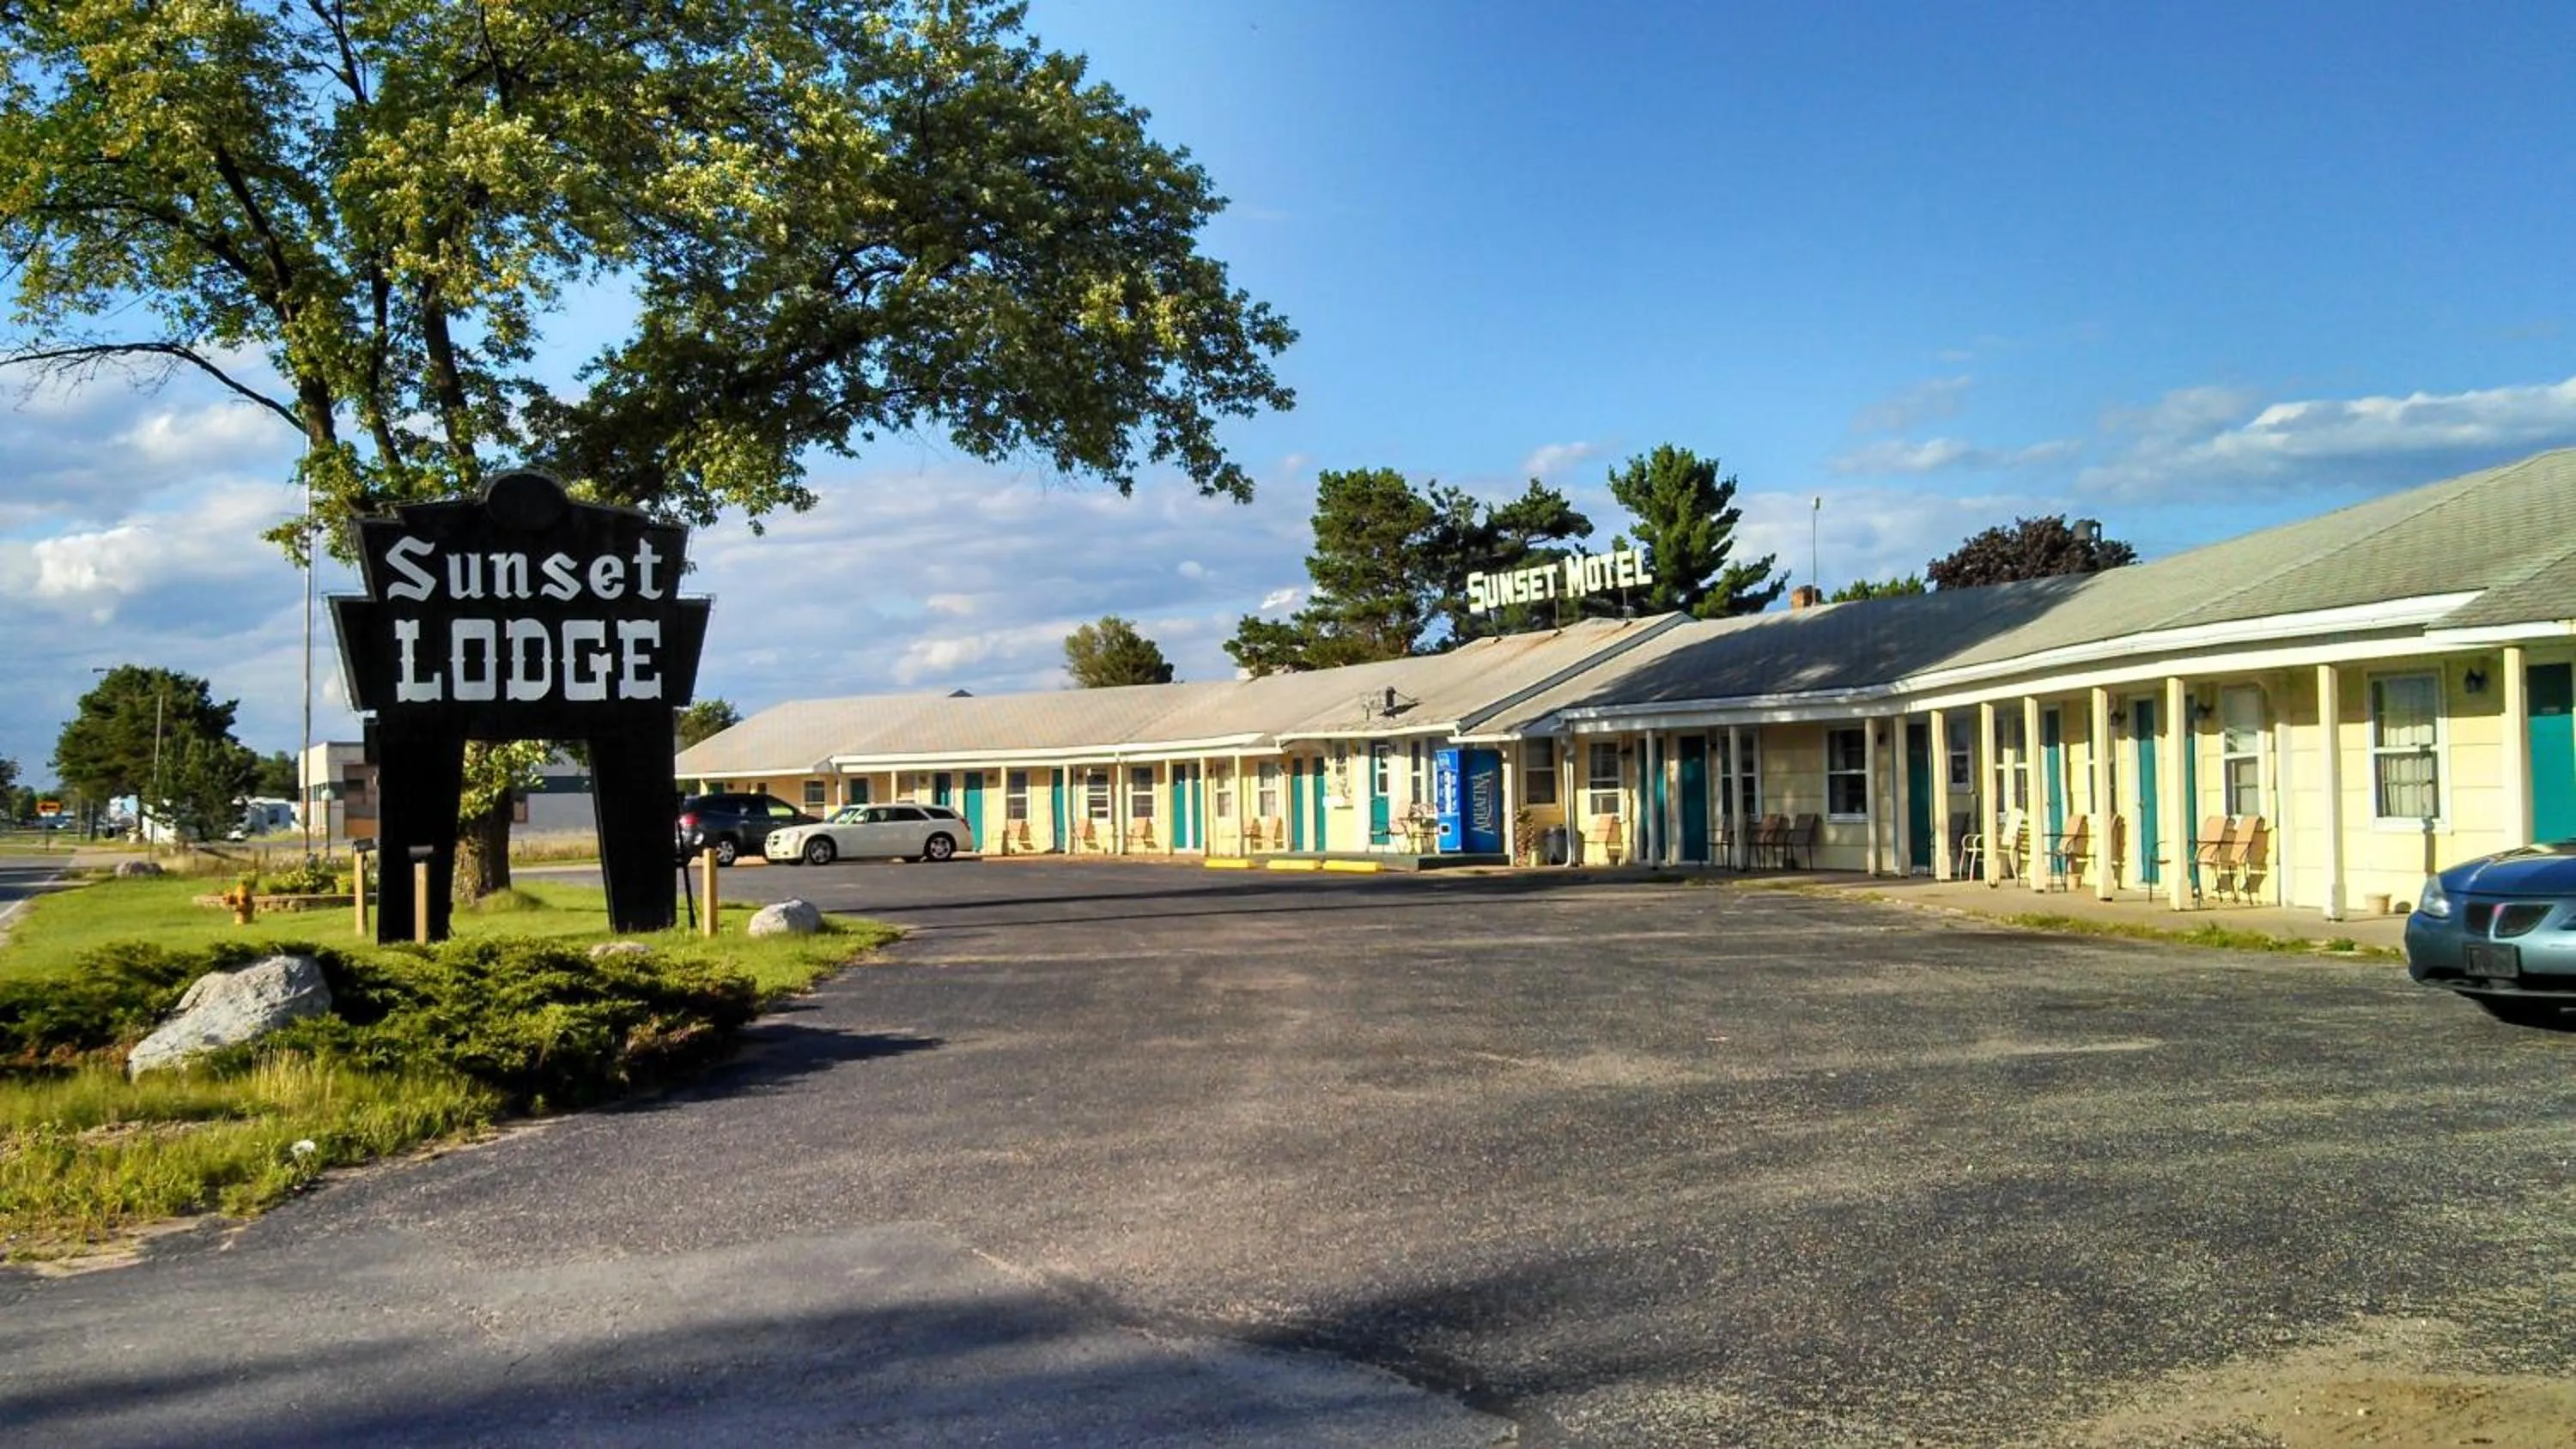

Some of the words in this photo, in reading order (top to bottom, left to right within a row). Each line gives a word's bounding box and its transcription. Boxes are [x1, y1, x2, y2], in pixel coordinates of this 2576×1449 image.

[386, 536, 664, 601] Sunset
[1467, 564, 1558, 613] SUNSET
[1565, 549, 1652, 598] MOTEL
[394, 618, 662, 702] LODGE
